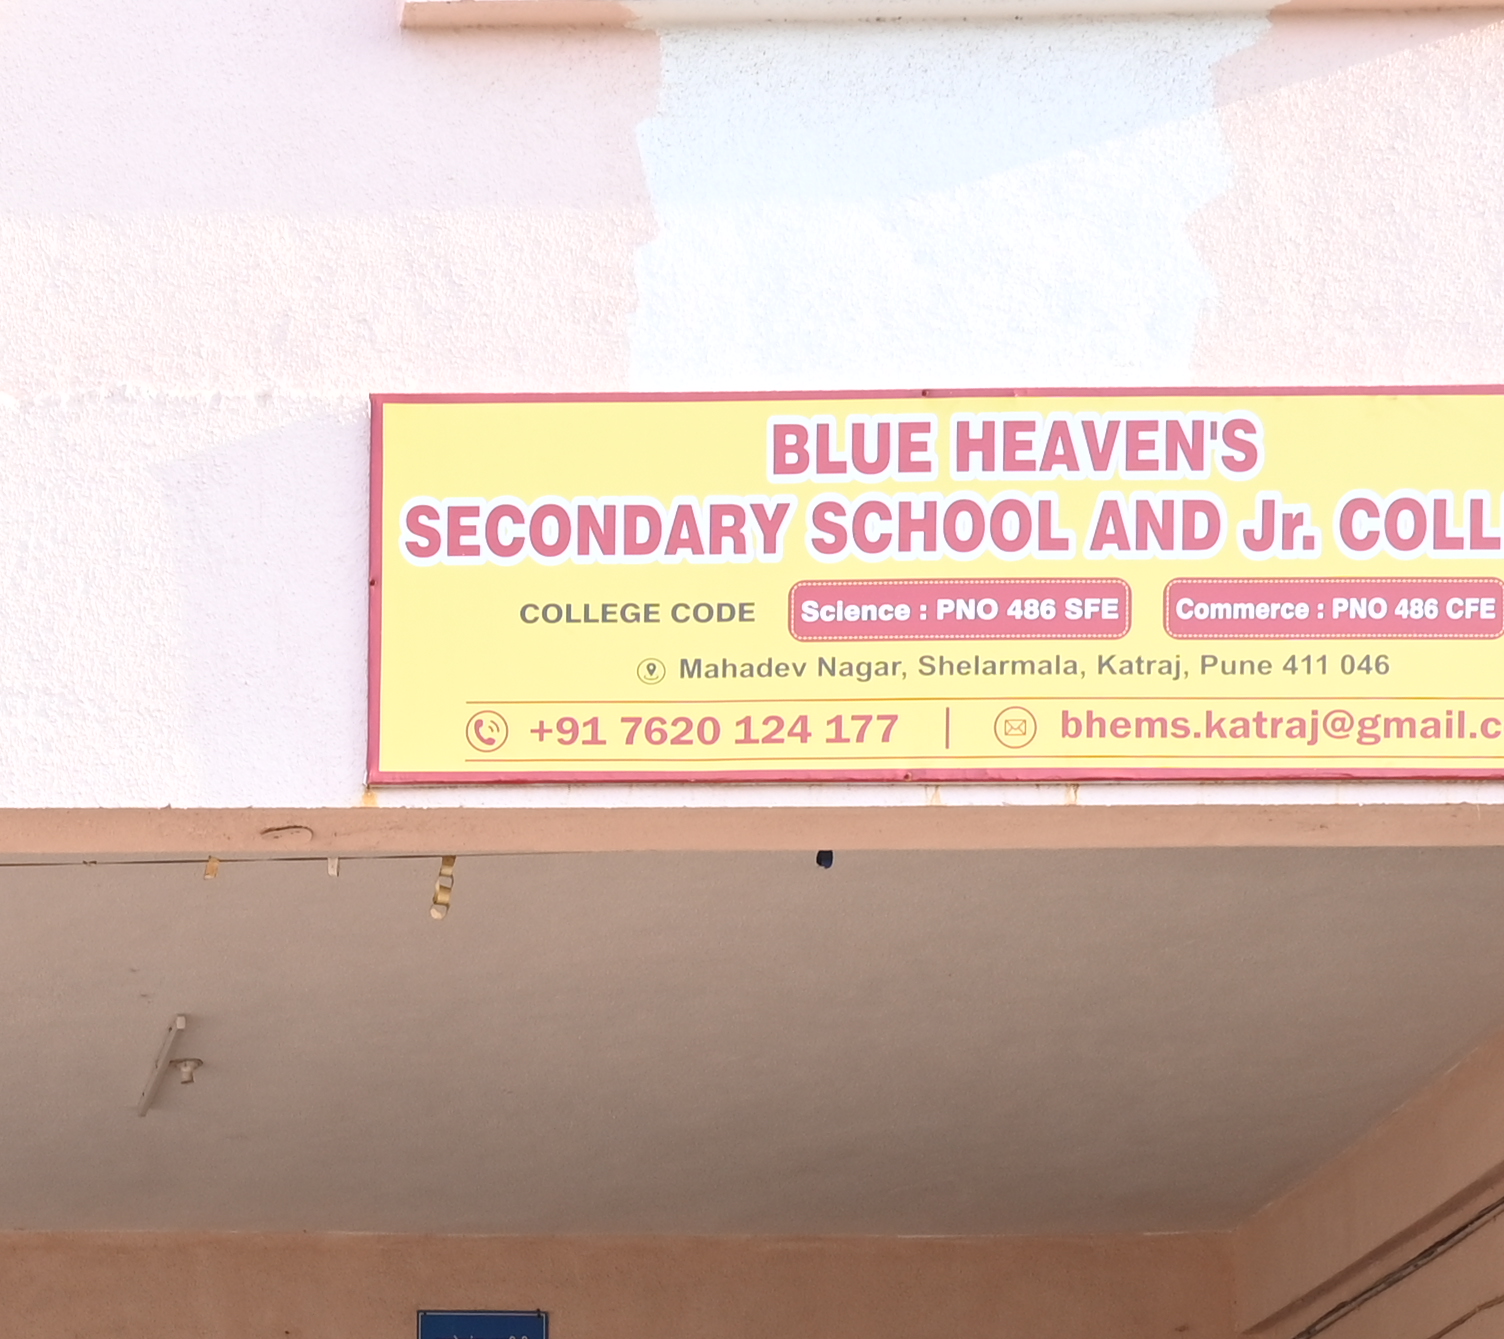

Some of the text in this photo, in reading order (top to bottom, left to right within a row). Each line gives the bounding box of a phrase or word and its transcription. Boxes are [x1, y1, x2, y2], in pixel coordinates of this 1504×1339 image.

[773, 419, 1258, 475] BLUE HEAVEN'S
[405, 502, 790, 558] SECONDARY
[811, 499, 1069, 554] SCHOOL
[1090, 499, 1221, 551] AND
[1243, 498, 1315, 552] Jr.
[519, 602, 755, 624] COLLEGE CODE
[800, 599, 911, 623] Science
[937, 598, 999, 620] PNO
[1007, 598, 1055, 620] 486
[1067, 598, 1119, 620] SFE
[1176, 598, 1310, 621] Commerce
[1332, 597, 1388, 620] PNO
[1395, 597, 1439, 620] 486
[1445, 597, 1496, 620] CFE
[679, 654, 1390, 682] Mahadev Nagar, Shelarmala, Katraj, Pune 411 046
[530, 714, 899, 746] +91 7620 124 177
